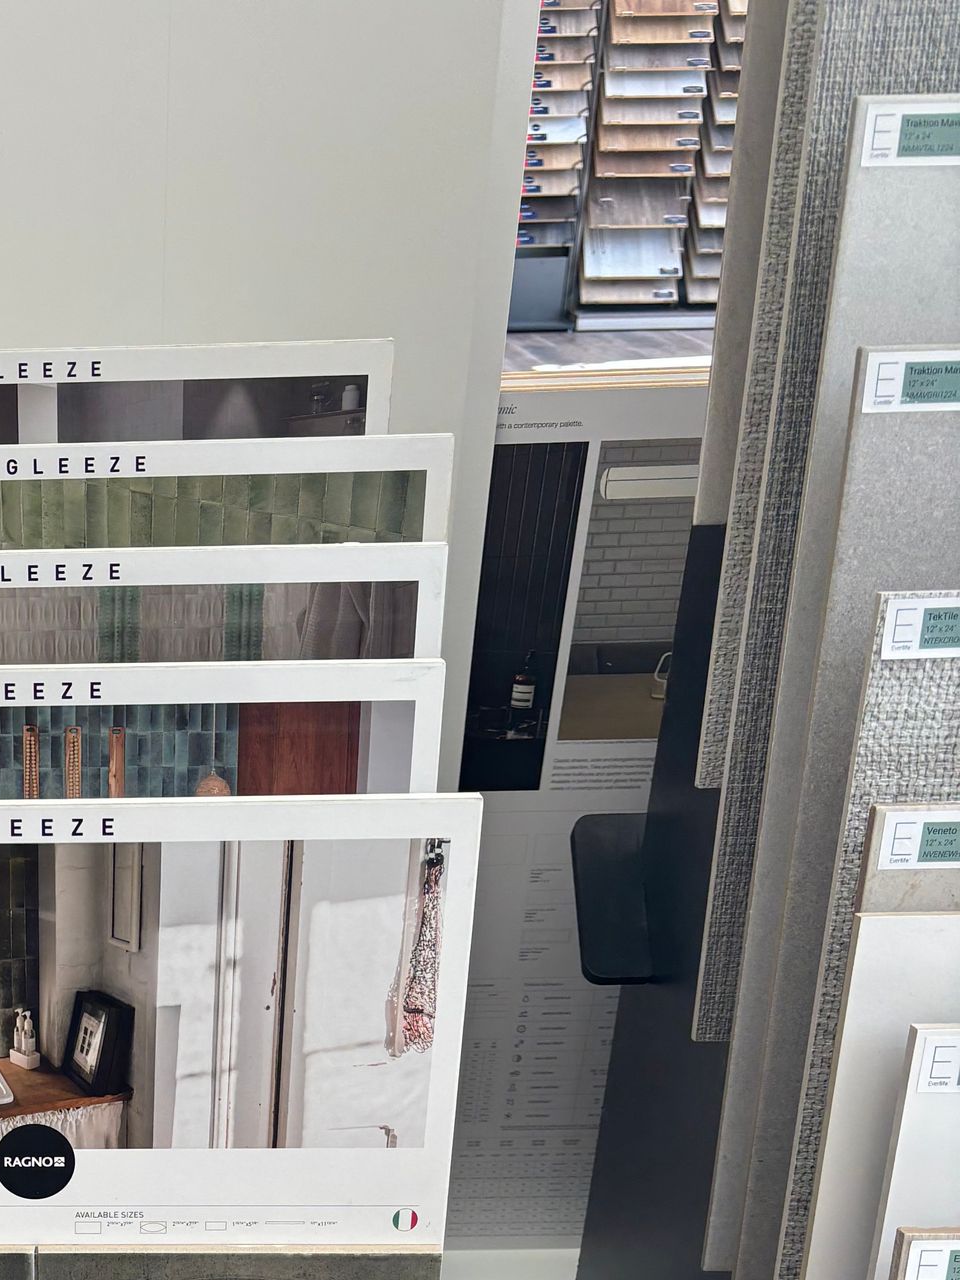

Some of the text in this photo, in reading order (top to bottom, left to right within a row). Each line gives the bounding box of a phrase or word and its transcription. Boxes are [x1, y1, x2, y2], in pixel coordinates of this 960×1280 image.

[6, 455, 146, 475] GLEEZE
[928, 612, 959, 621] TekTile
[927, 826, 958, 835] Veneto
[3, 1156, 54, 1168] RAGNO
[75, 1211, 144, 1219] AVAILABLE SIZES
